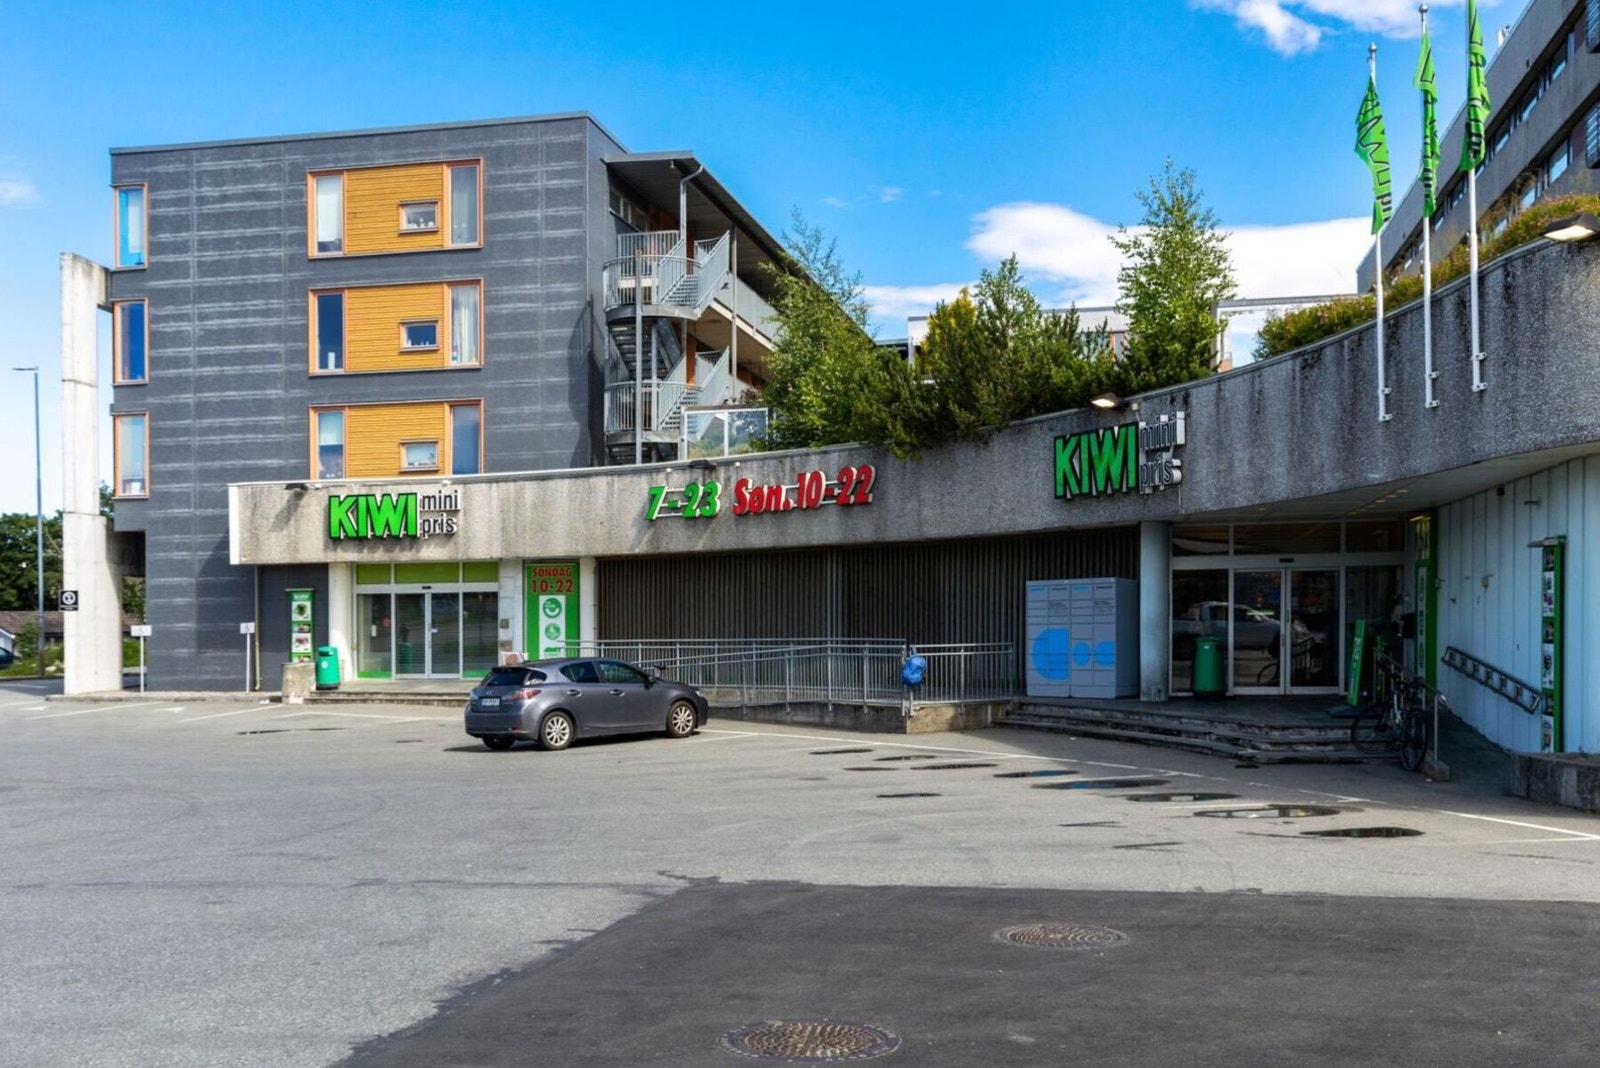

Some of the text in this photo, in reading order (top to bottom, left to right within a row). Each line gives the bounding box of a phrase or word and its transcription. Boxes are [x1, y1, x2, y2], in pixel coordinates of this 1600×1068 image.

[1140, 411, 1183, 449] mini
[1054, 422, 1140, 499] KIWI
[1140, 452, 1179, 494] pris
[328, 493, 417, 539] KIWI
[422, 490, 459, 510] mini
[422, 513, 456, 538] pris
[533, 567, 572, 577] SØNDAG
